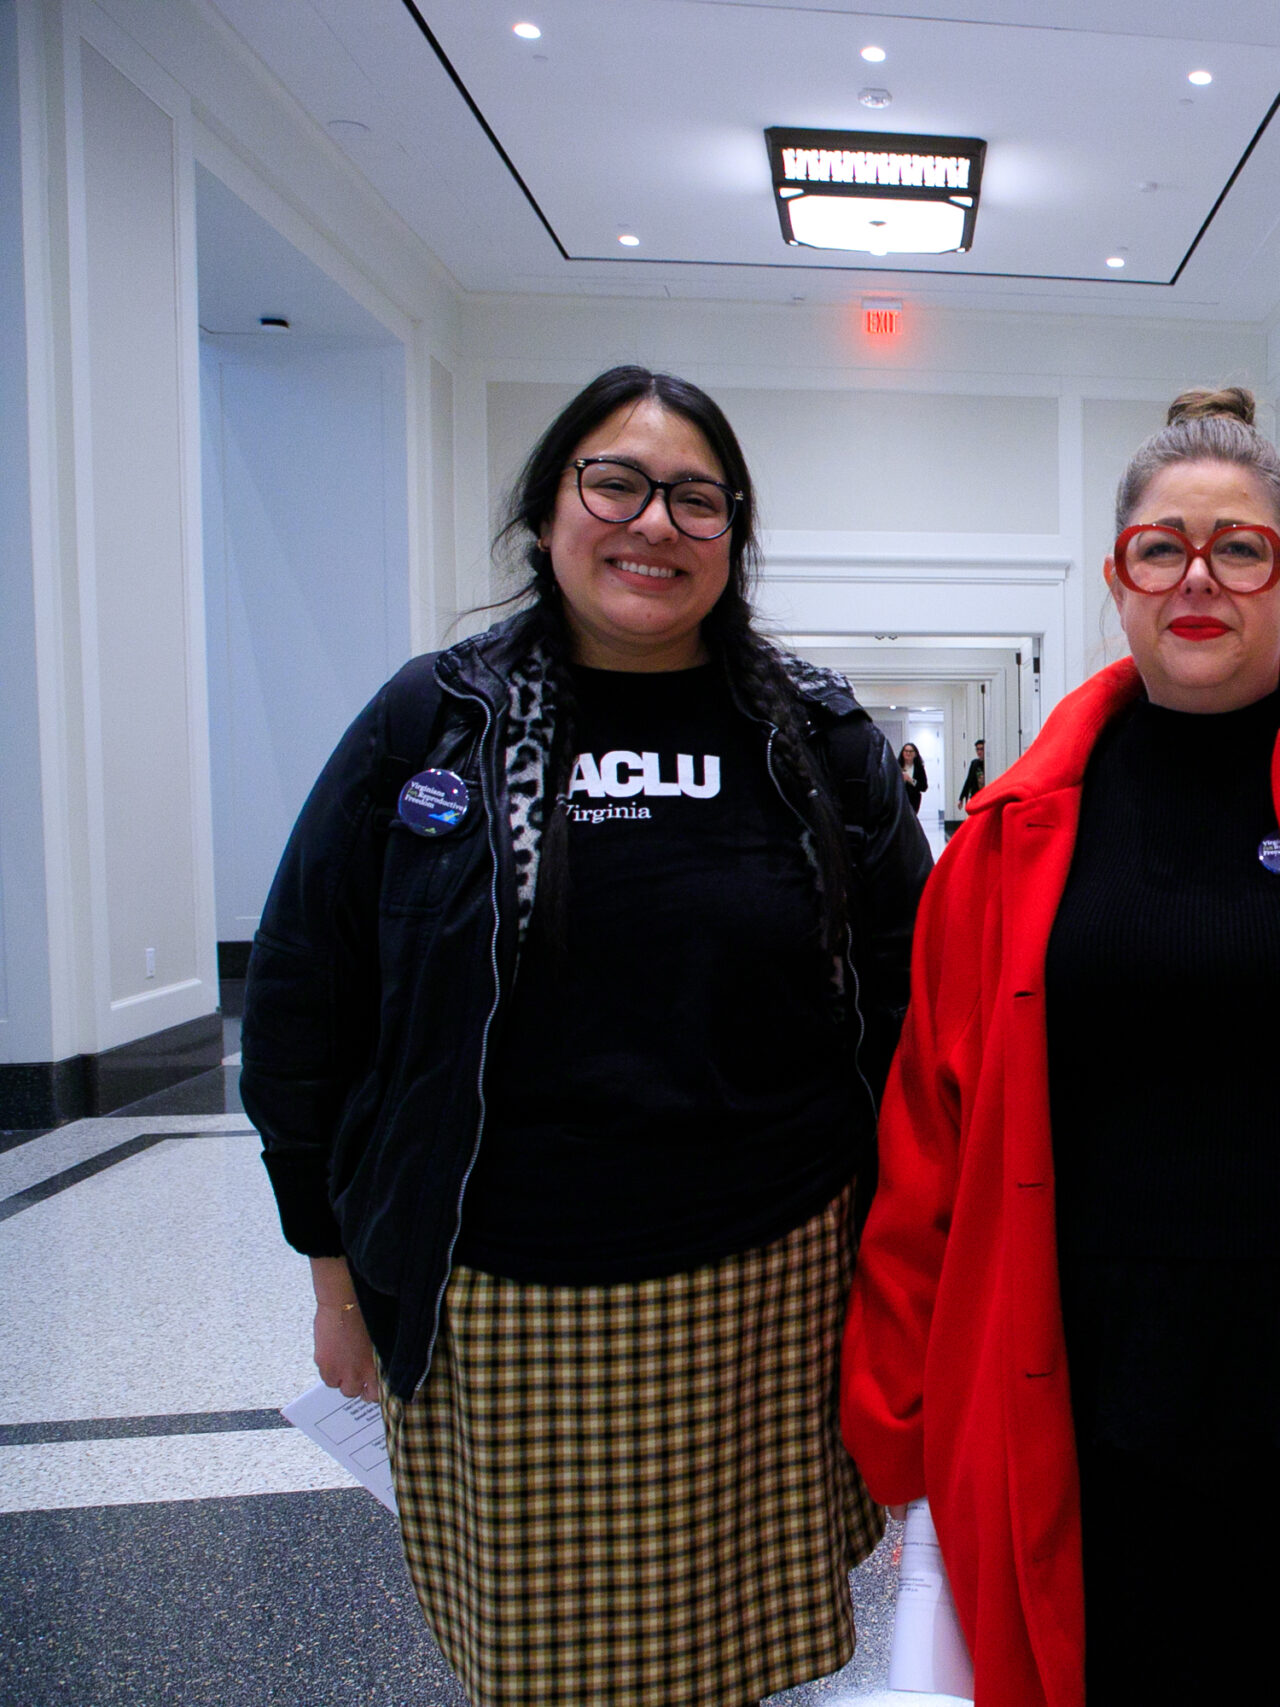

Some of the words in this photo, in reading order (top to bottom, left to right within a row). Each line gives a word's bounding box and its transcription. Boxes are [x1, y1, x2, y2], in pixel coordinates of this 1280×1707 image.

[867, 311, 898, 334] EXIT
[567, 750, 721, 799] ACLU
[411, 781, 446, 797] Virginians
[404, 794, 435, 809] Freedom
